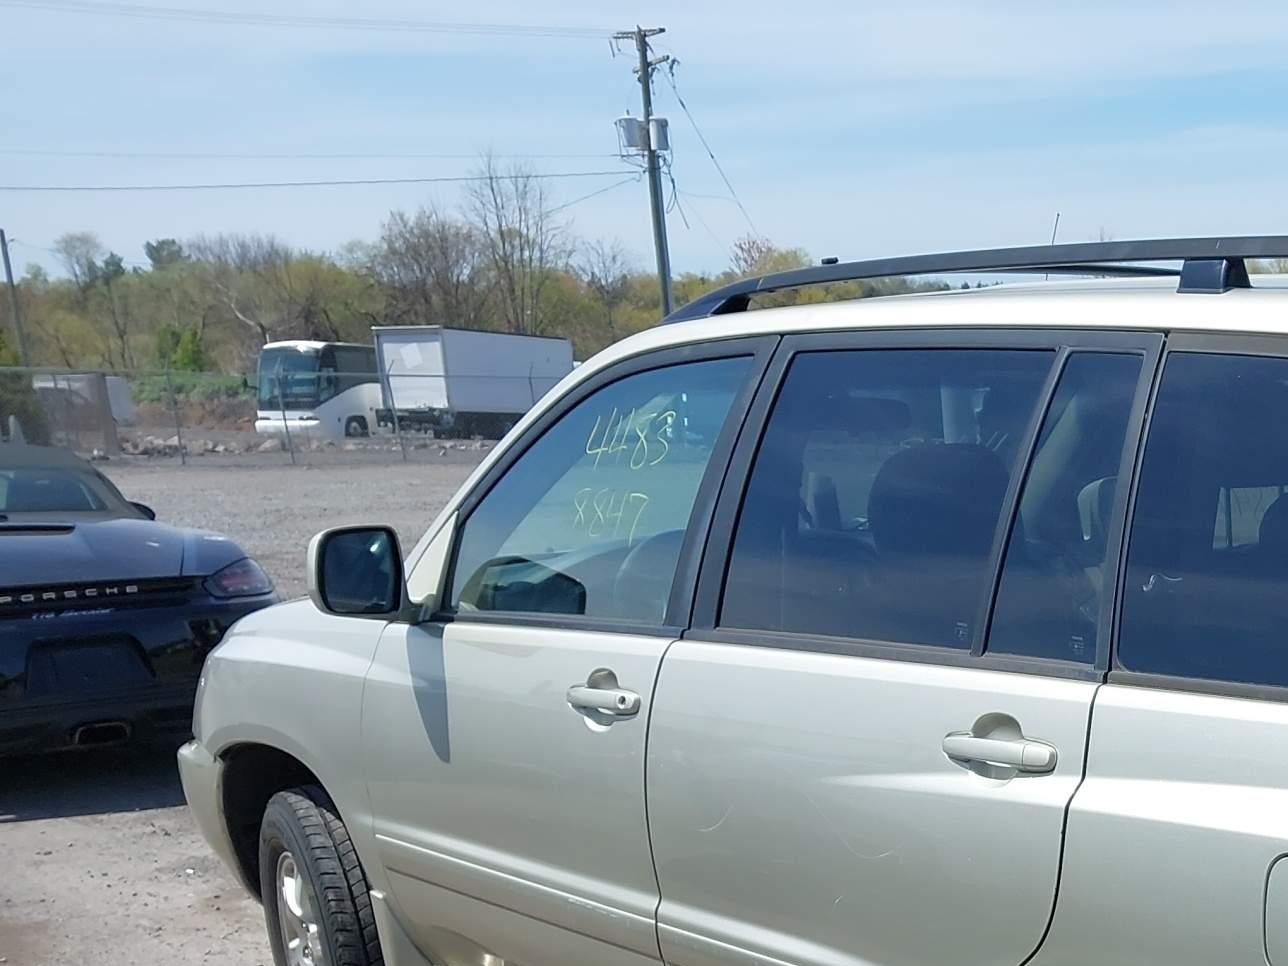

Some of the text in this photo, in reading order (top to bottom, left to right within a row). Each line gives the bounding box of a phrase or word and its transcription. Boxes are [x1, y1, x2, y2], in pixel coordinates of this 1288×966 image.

[585, 407, 677, 472] 4483
[572, 487, 650, 549] 8847
[0, 584, 139, 604] PORSCHE
